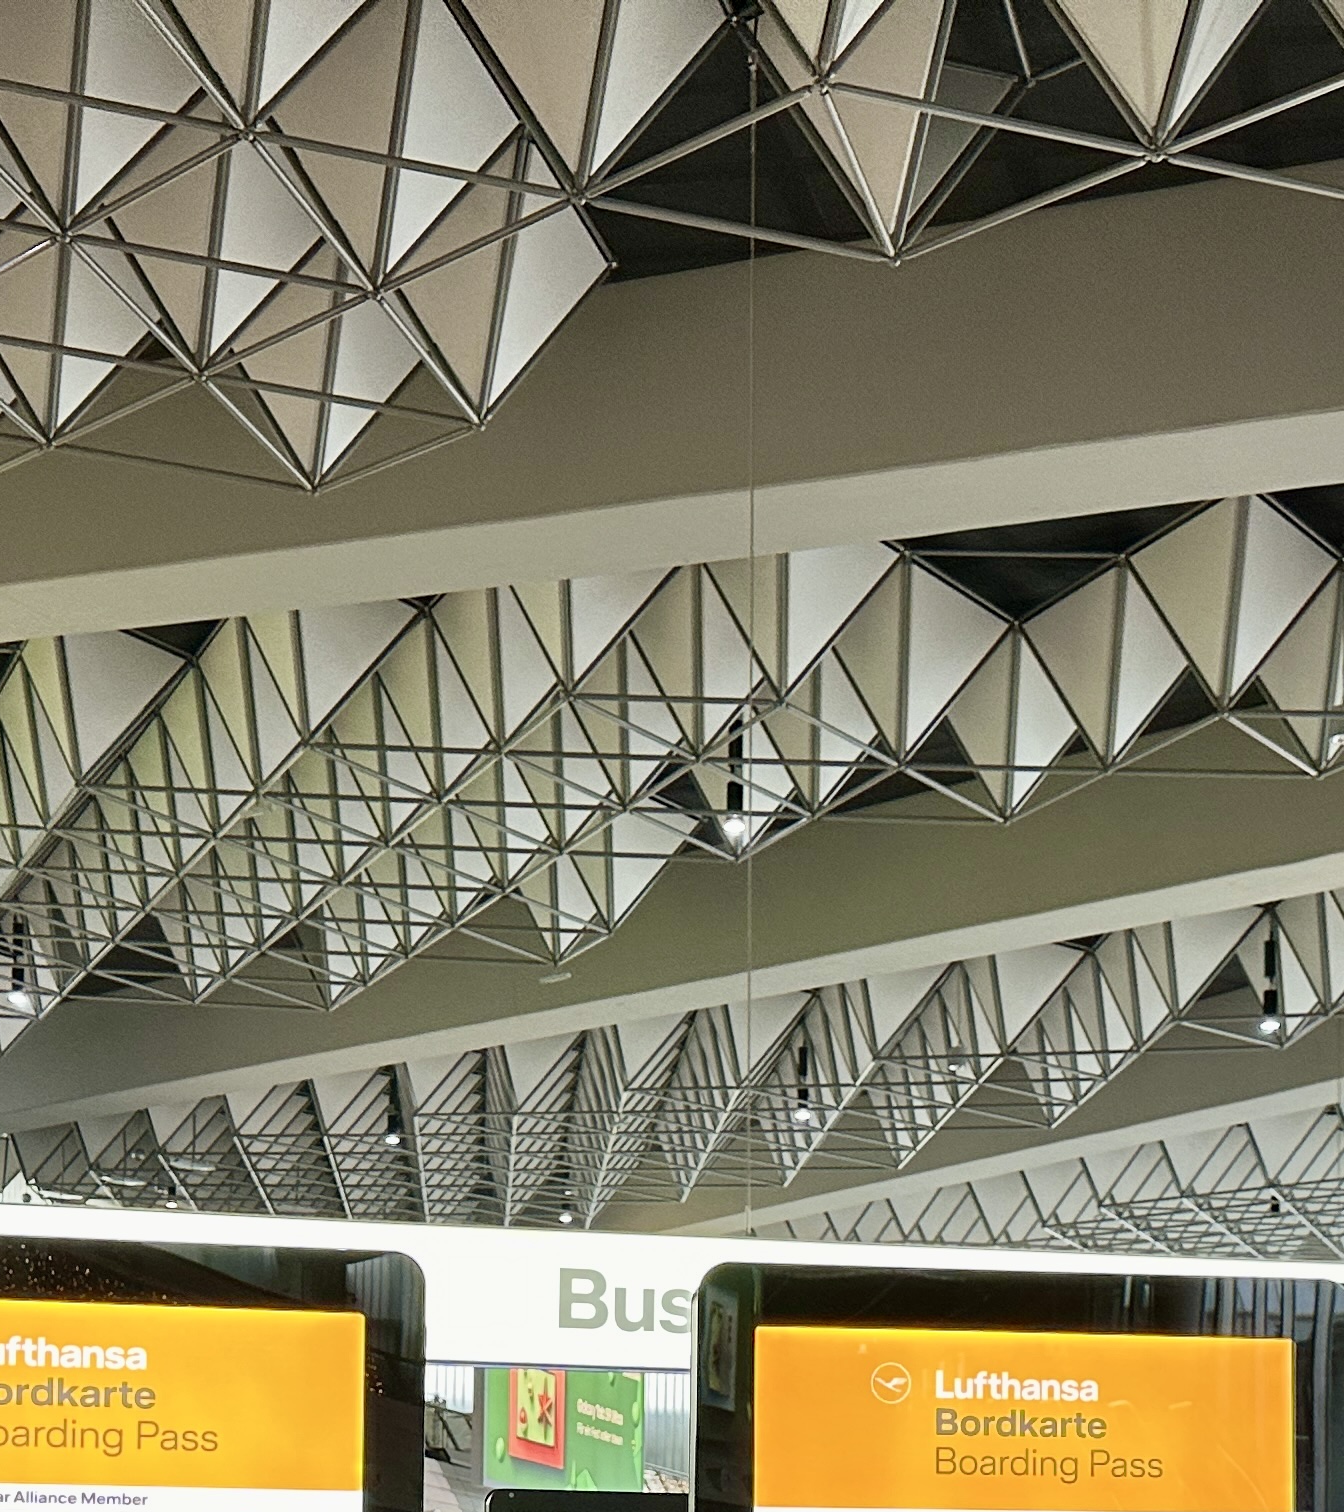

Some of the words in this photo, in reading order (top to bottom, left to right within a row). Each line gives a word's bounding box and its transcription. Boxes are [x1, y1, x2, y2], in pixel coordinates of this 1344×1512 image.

[559, 1267, 692, 1334] Bus
[934, 1368, 1099, 1402] Lufthansa
[137, 1420, 219, 1452] Pass
[935, 1407, 1107, 1440] Bordkarte
[935, 1446, 1079, 1484] Boarding
[1090, 1449, 1164, 1479] Pass
[13, 1490, 78, 1505] Alliance
[81, 1492, 149, 1506] Member
